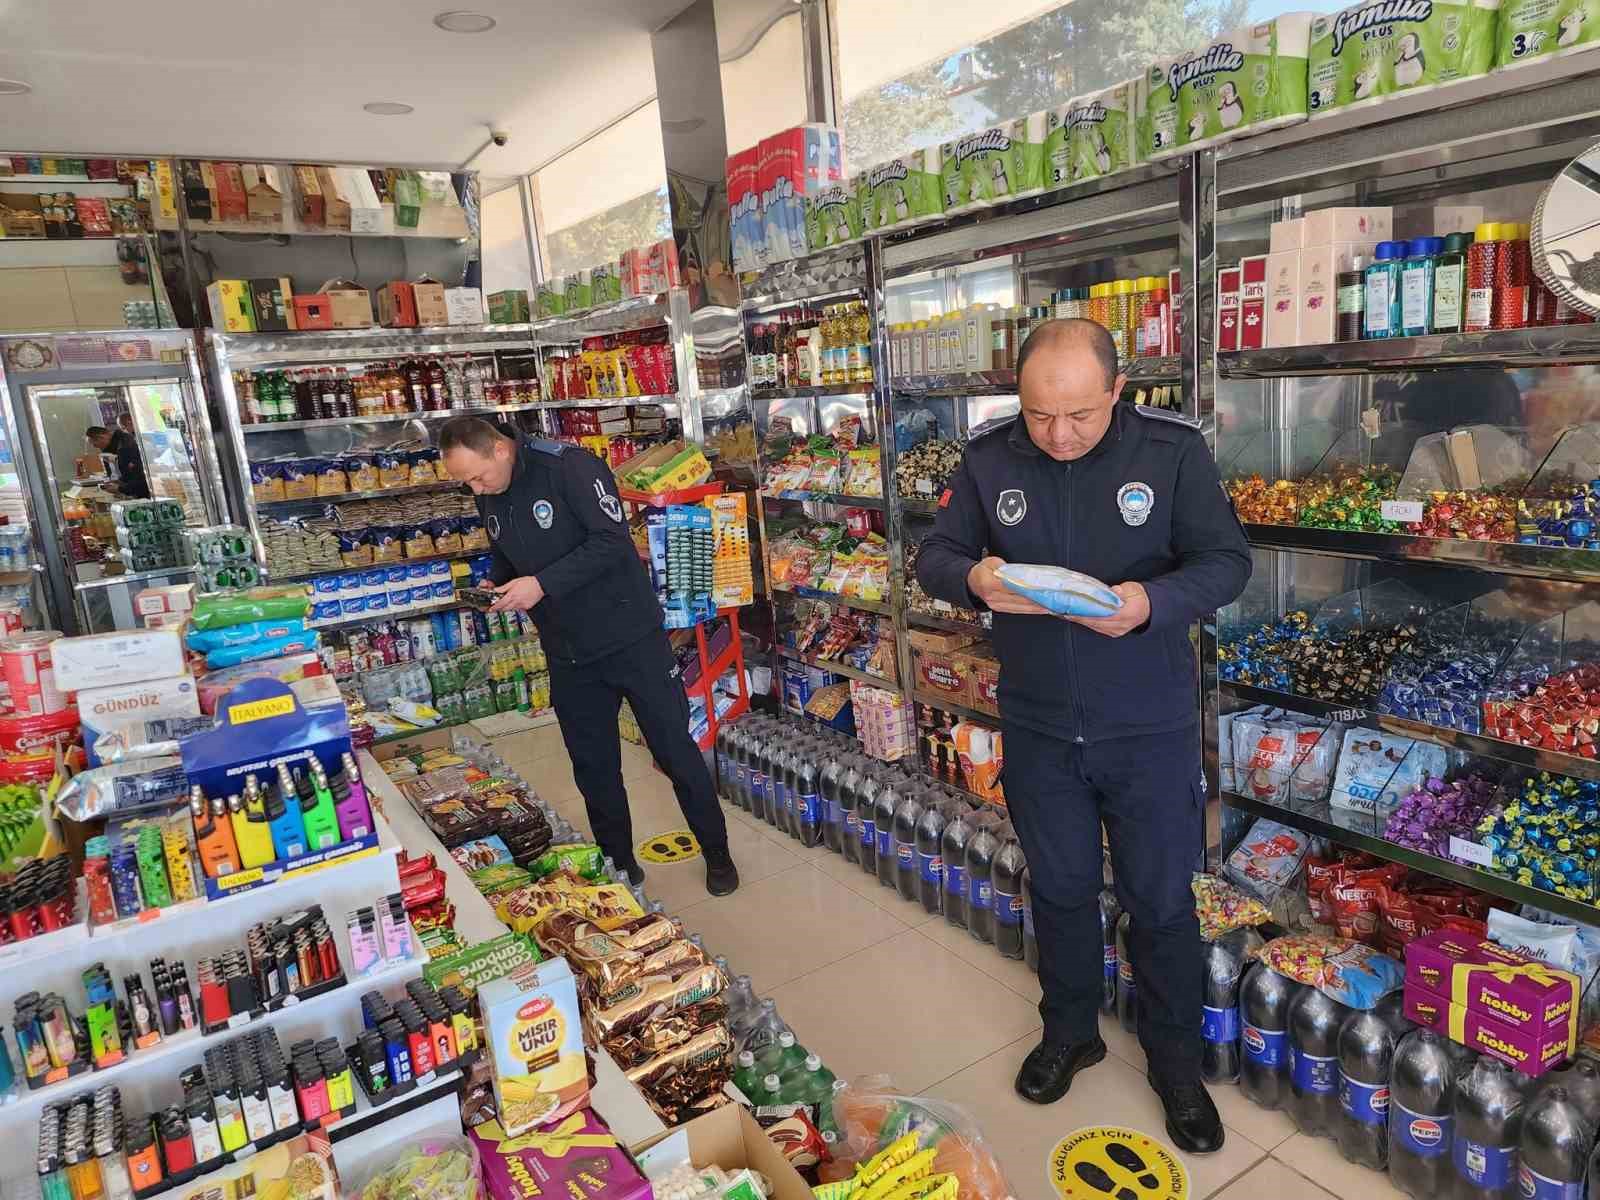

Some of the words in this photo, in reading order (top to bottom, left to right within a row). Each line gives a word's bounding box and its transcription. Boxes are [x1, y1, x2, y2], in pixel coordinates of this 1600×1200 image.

[1363, 25, 1393, 42] PLUS
[1513, 34, 1527, 56] 3
[1168, 43, 1244, 102] familia
[1310, 91, 1321, 109] 3
[1153, 132, 1163, 148] 3
[94, 693, 160, 714] GÜNDÜZ
[1512, 944, 1548, 960] Multi
[1480, 992, 1532, 1022] hobby
[518, 1018, 559, 1042] MISIR
[521, 1030, 557, 1052] UNU
[1476, 1031, 1529, 1062] hobby
[1411, 1126, 1441, 1137] PEPSI
